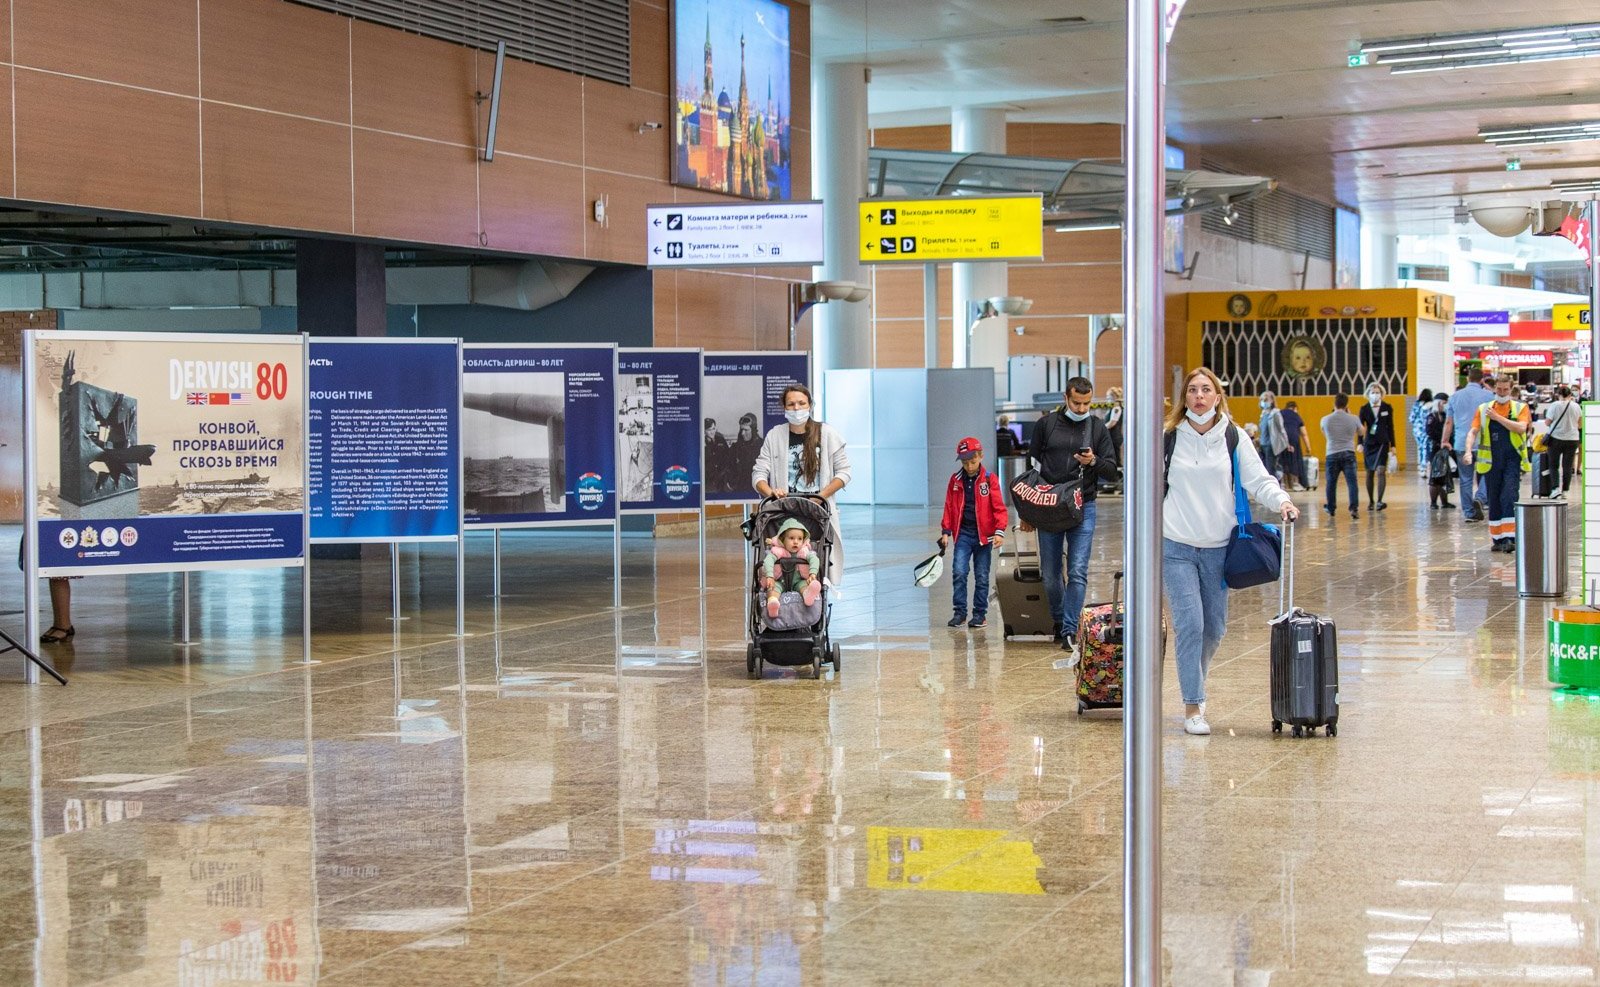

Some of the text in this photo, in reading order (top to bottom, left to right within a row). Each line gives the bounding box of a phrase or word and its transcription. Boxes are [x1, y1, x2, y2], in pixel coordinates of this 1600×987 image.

[721, 214, 748, 222] матери
[902, 239, 914, 251] D
[169, 358, 287, 400] DERVISH 80
[348, 391, 372, 399] TIME
[199, 420, 260, 435] КОНВОЙ,
[173, 436, 284, 451] ПРОРВАВШИЙСЯ
[180, 456, 277, 468] СКВОЗЬ ВРЕМЯ
[1550, 642, 1600, 660] PACK&F
